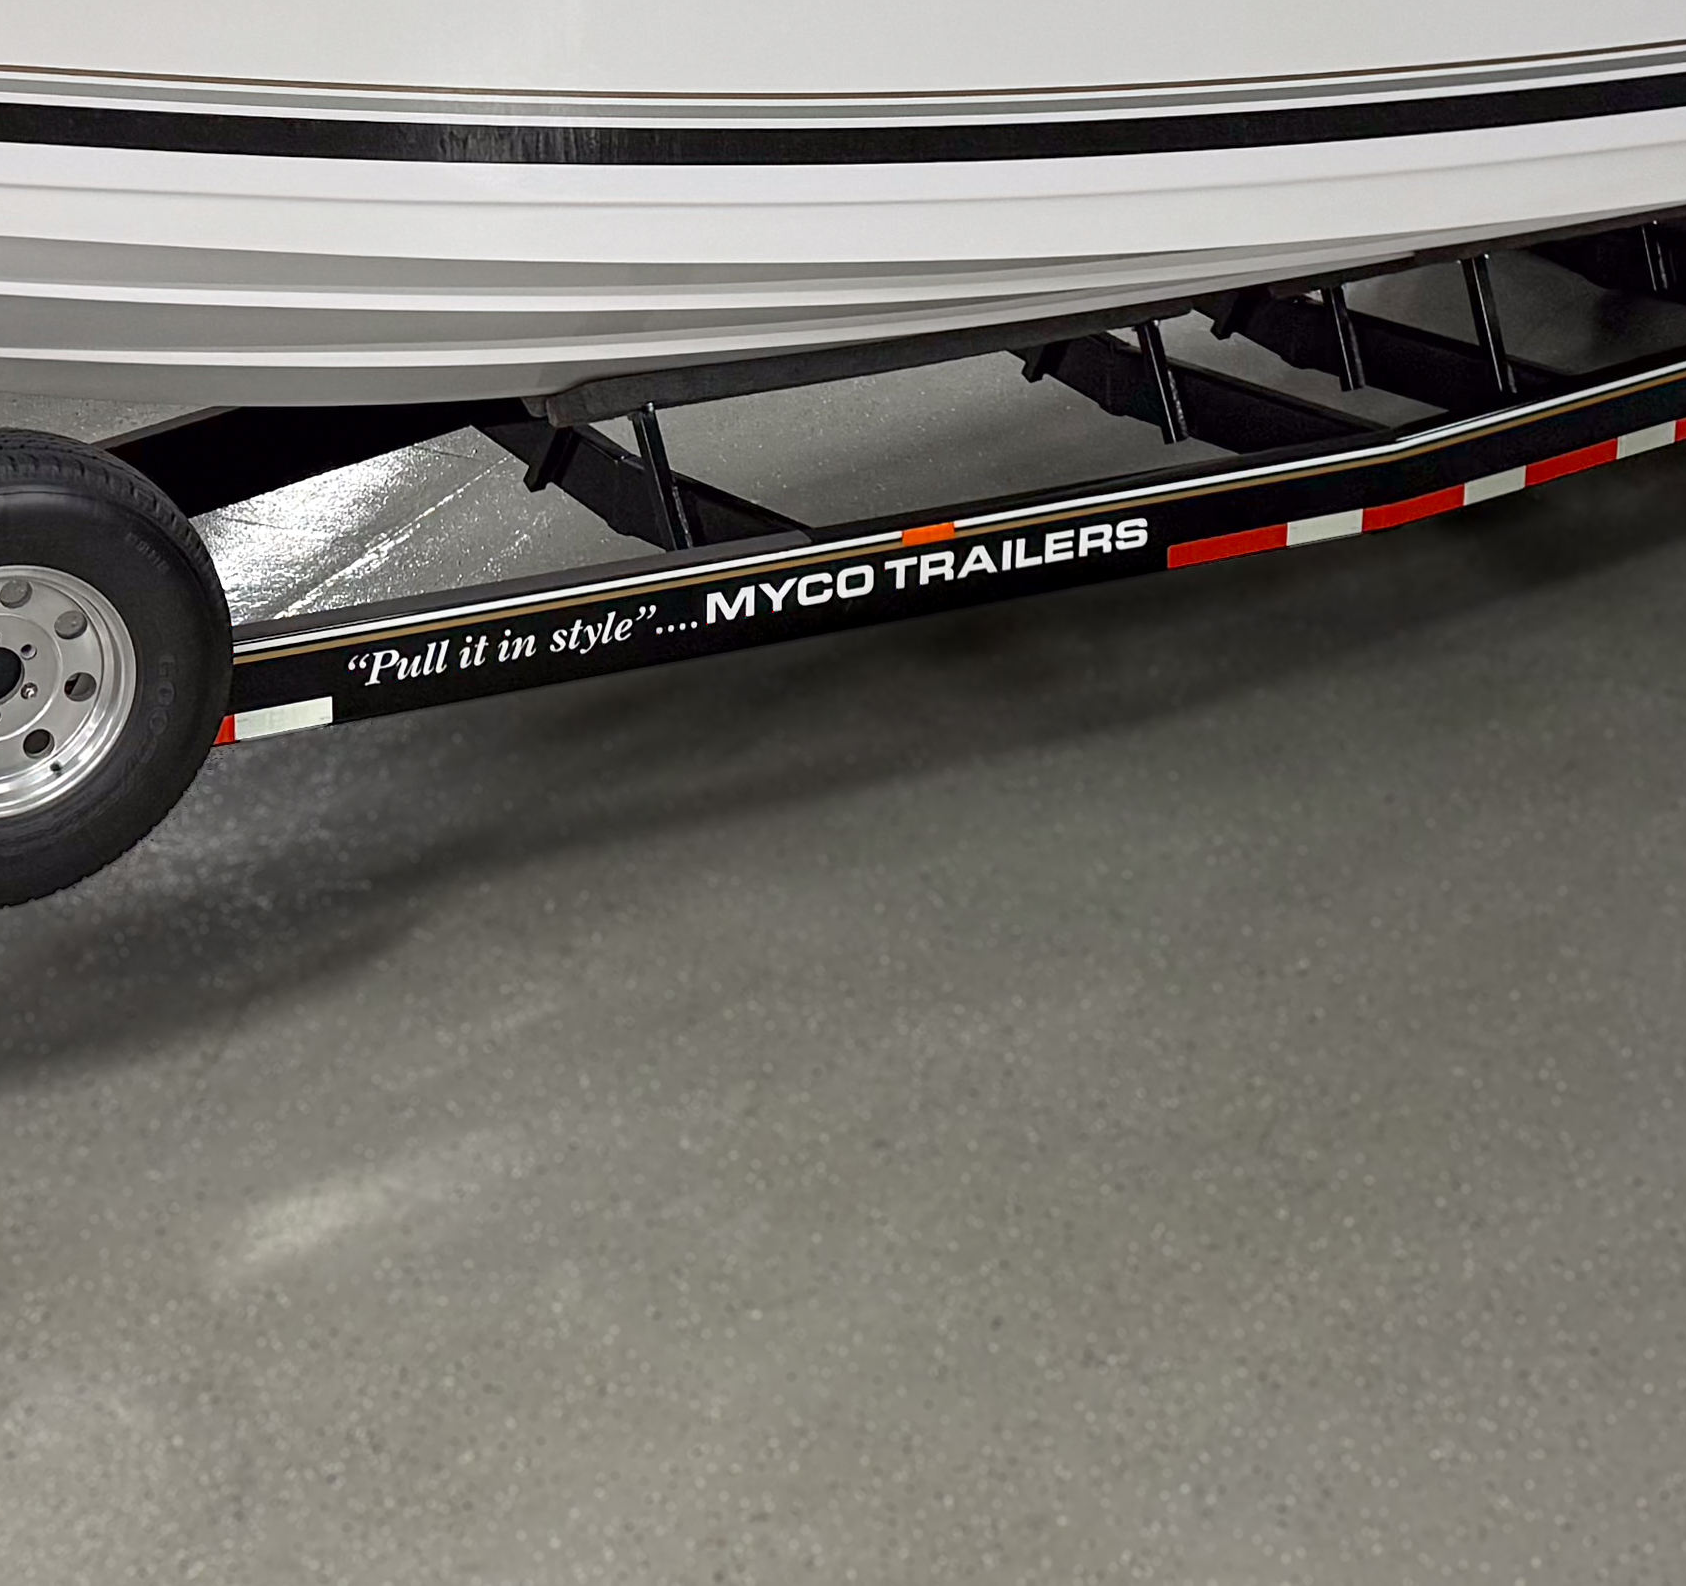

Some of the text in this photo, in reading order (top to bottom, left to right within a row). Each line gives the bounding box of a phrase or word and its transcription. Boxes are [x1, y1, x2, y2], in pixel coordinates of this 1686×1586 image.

[460, 633, 489, 670] it
[498, 629, 537, 664] in
[705, 562, 875, 626] MYCO
[884, 516, 1150, 591] TRAILERS
